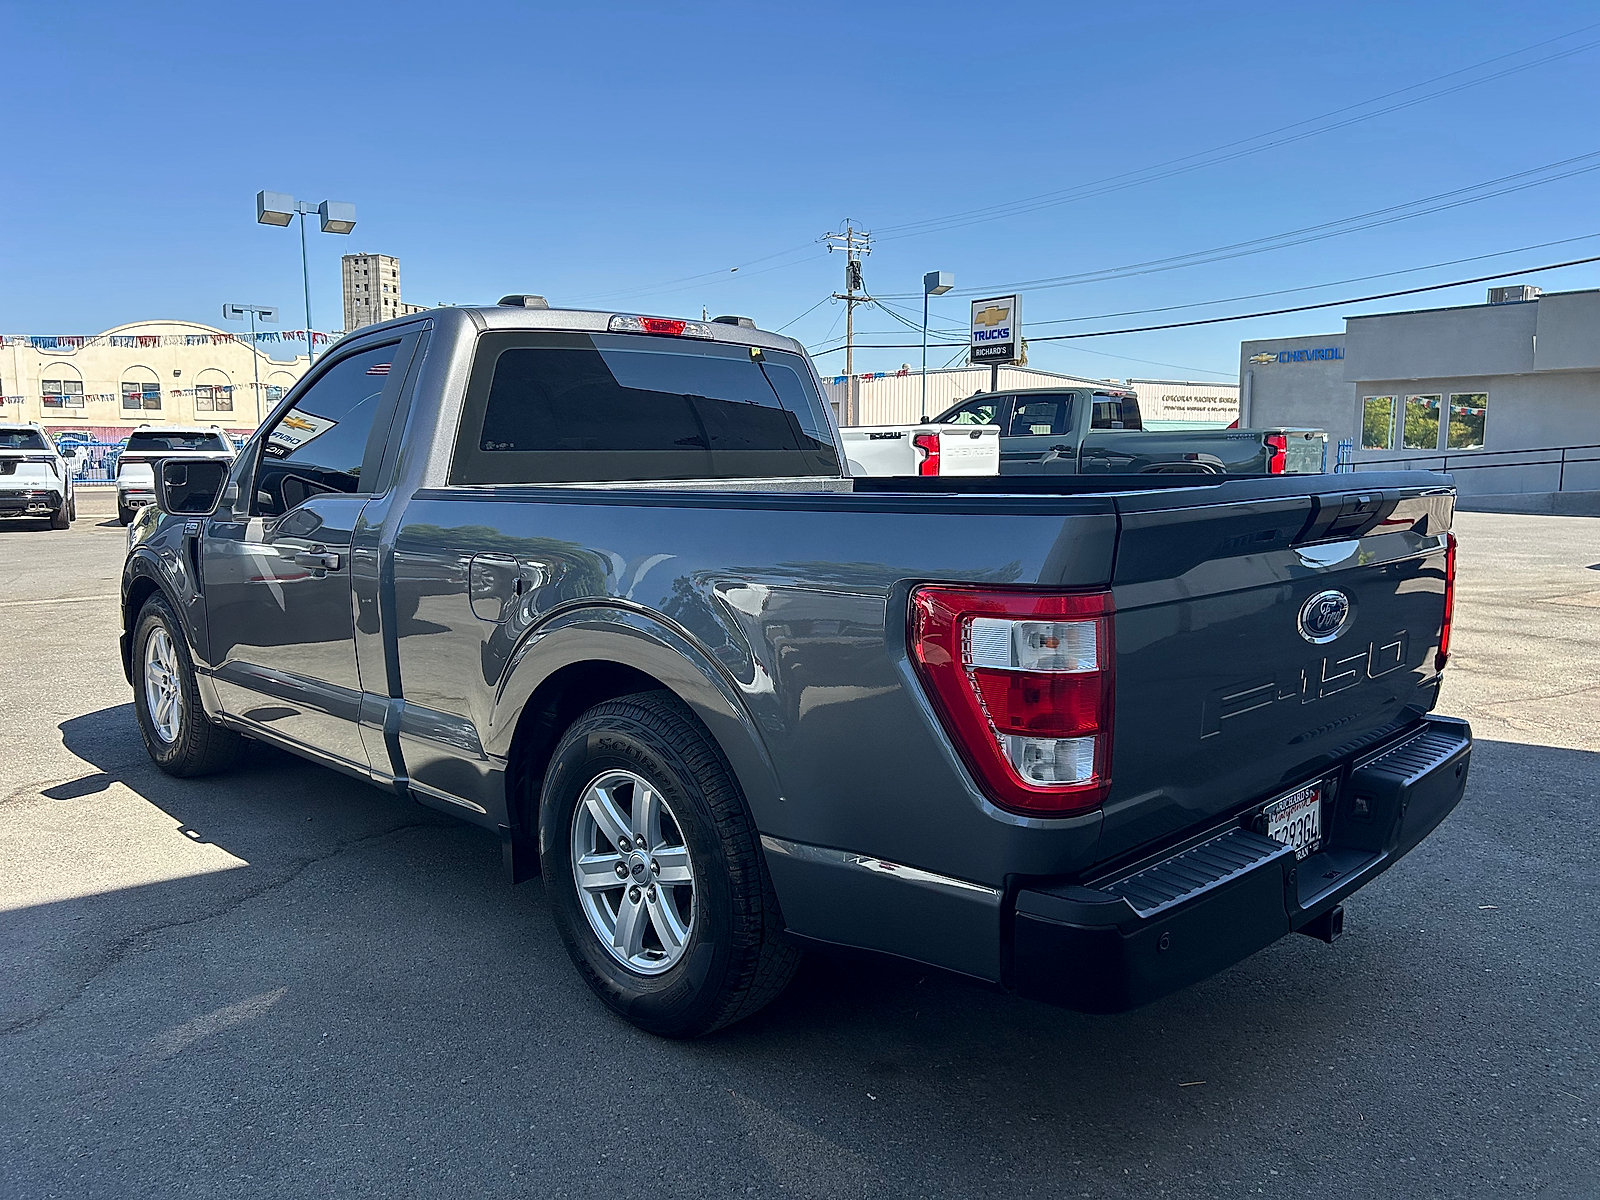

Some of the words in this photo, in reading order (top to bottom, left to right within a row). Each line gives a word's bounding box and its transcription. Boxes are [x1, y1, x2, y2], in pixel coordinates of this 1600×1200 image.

[973, 327, 1010, 341] TRUCKS
[975, 346, 1007, 356] RICHARD'S
[1316, 600, 1343, 629] Ford
[1200, 629, 1410, 740] F-150
